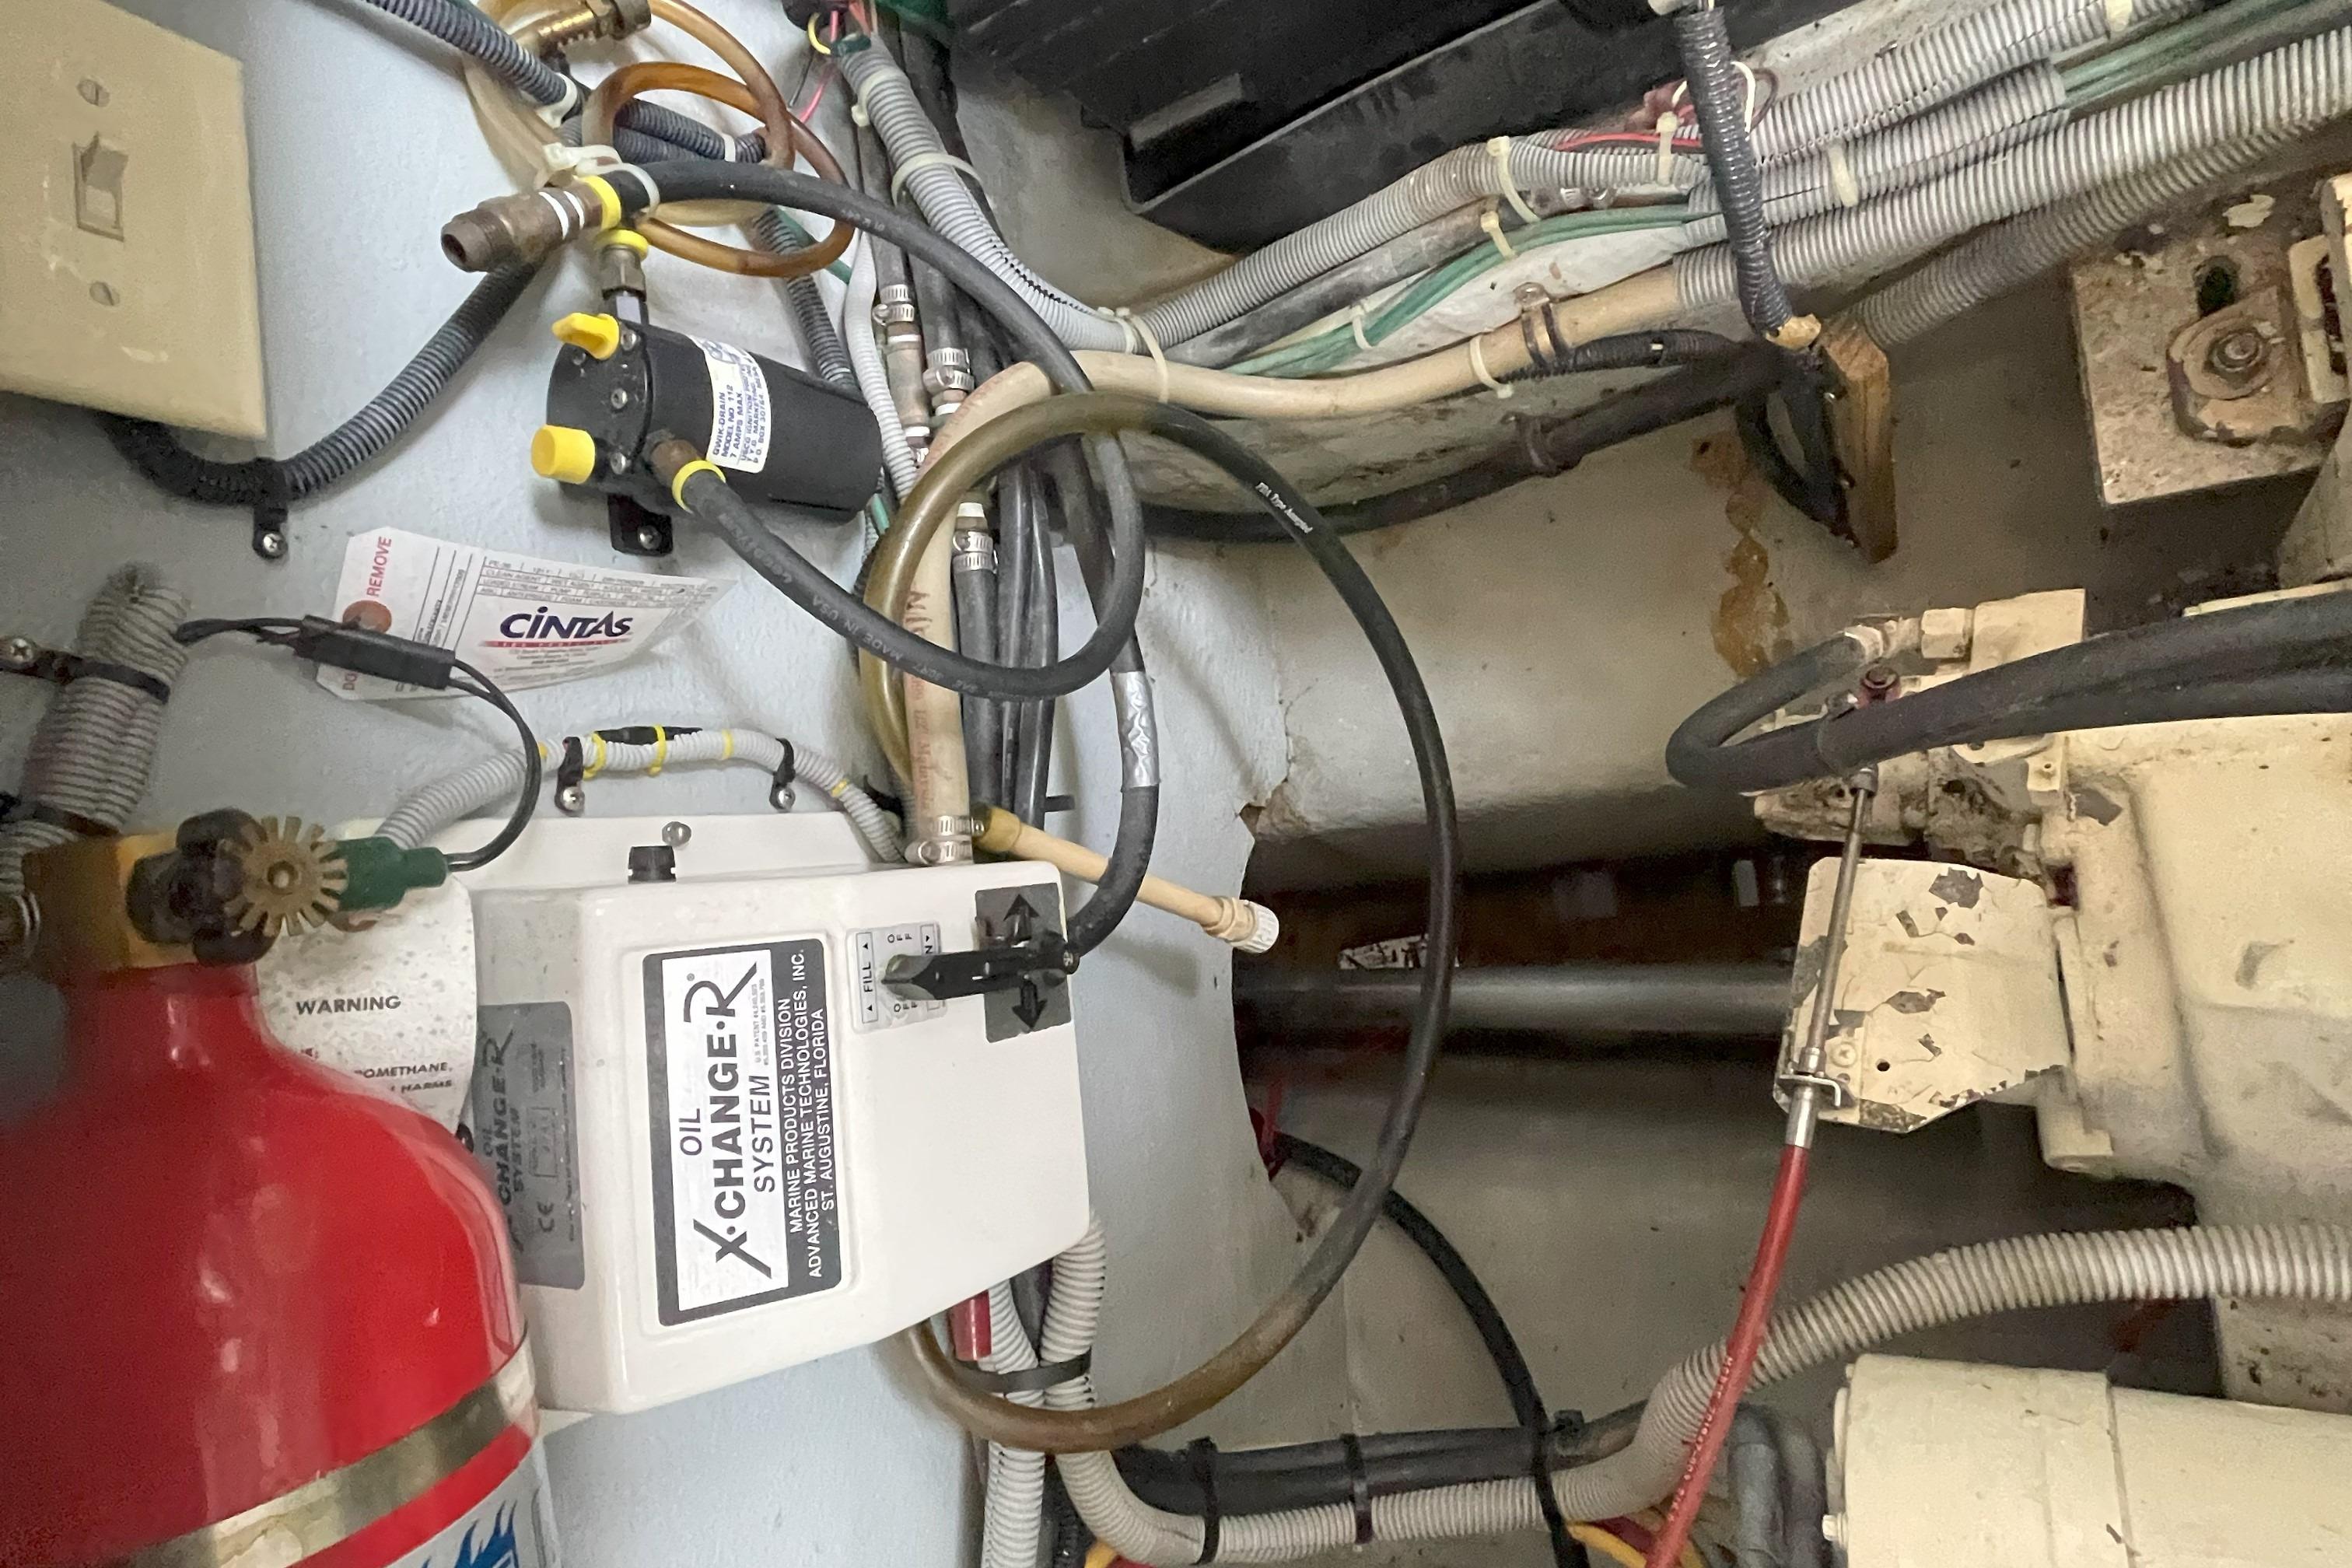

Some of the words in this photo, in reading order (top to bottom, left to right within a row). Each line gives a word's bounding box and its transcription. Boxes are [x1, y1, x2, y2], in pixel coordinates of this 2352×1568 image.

[722, 425, 734, 457] MODEL
[733, 419, 744, 450] AMPS
[367, 536, 392, 597] REMOVE
[813, 595, 839, 621] USA
[845, 621, 859, 635] IN
[863, 632, 905, 662] MADE
[791, 949, 806, 982] INC.
[863, 961, 873, 992] FILL
[296, 996, 401, 1016] WARNING
[778, 999, 794, 1070] DIVISION
[793, 985, 814, 1118] TECHNOLOGIES,
[811, 1008, 827, 1078] FLORIDA
[482, 1128, 494, 1158] OIL
[678, 1108, 702, 1156] OIL
[748, 1075, 775, 1192] SYSTEM
[782, 1074, 800, 1164] PRODUCTS
[815, 1082, 834, 1180] AUGUSTINE,
[509, 1107, 524, 1192] SYSTEM
[801, 1121, 817, 1185] MARINE
[537, 1201, 555, 1233] CE
[787, 1168, 803, 1234] MARINE
[804, 1189, 822, 1278] ADVANCED
